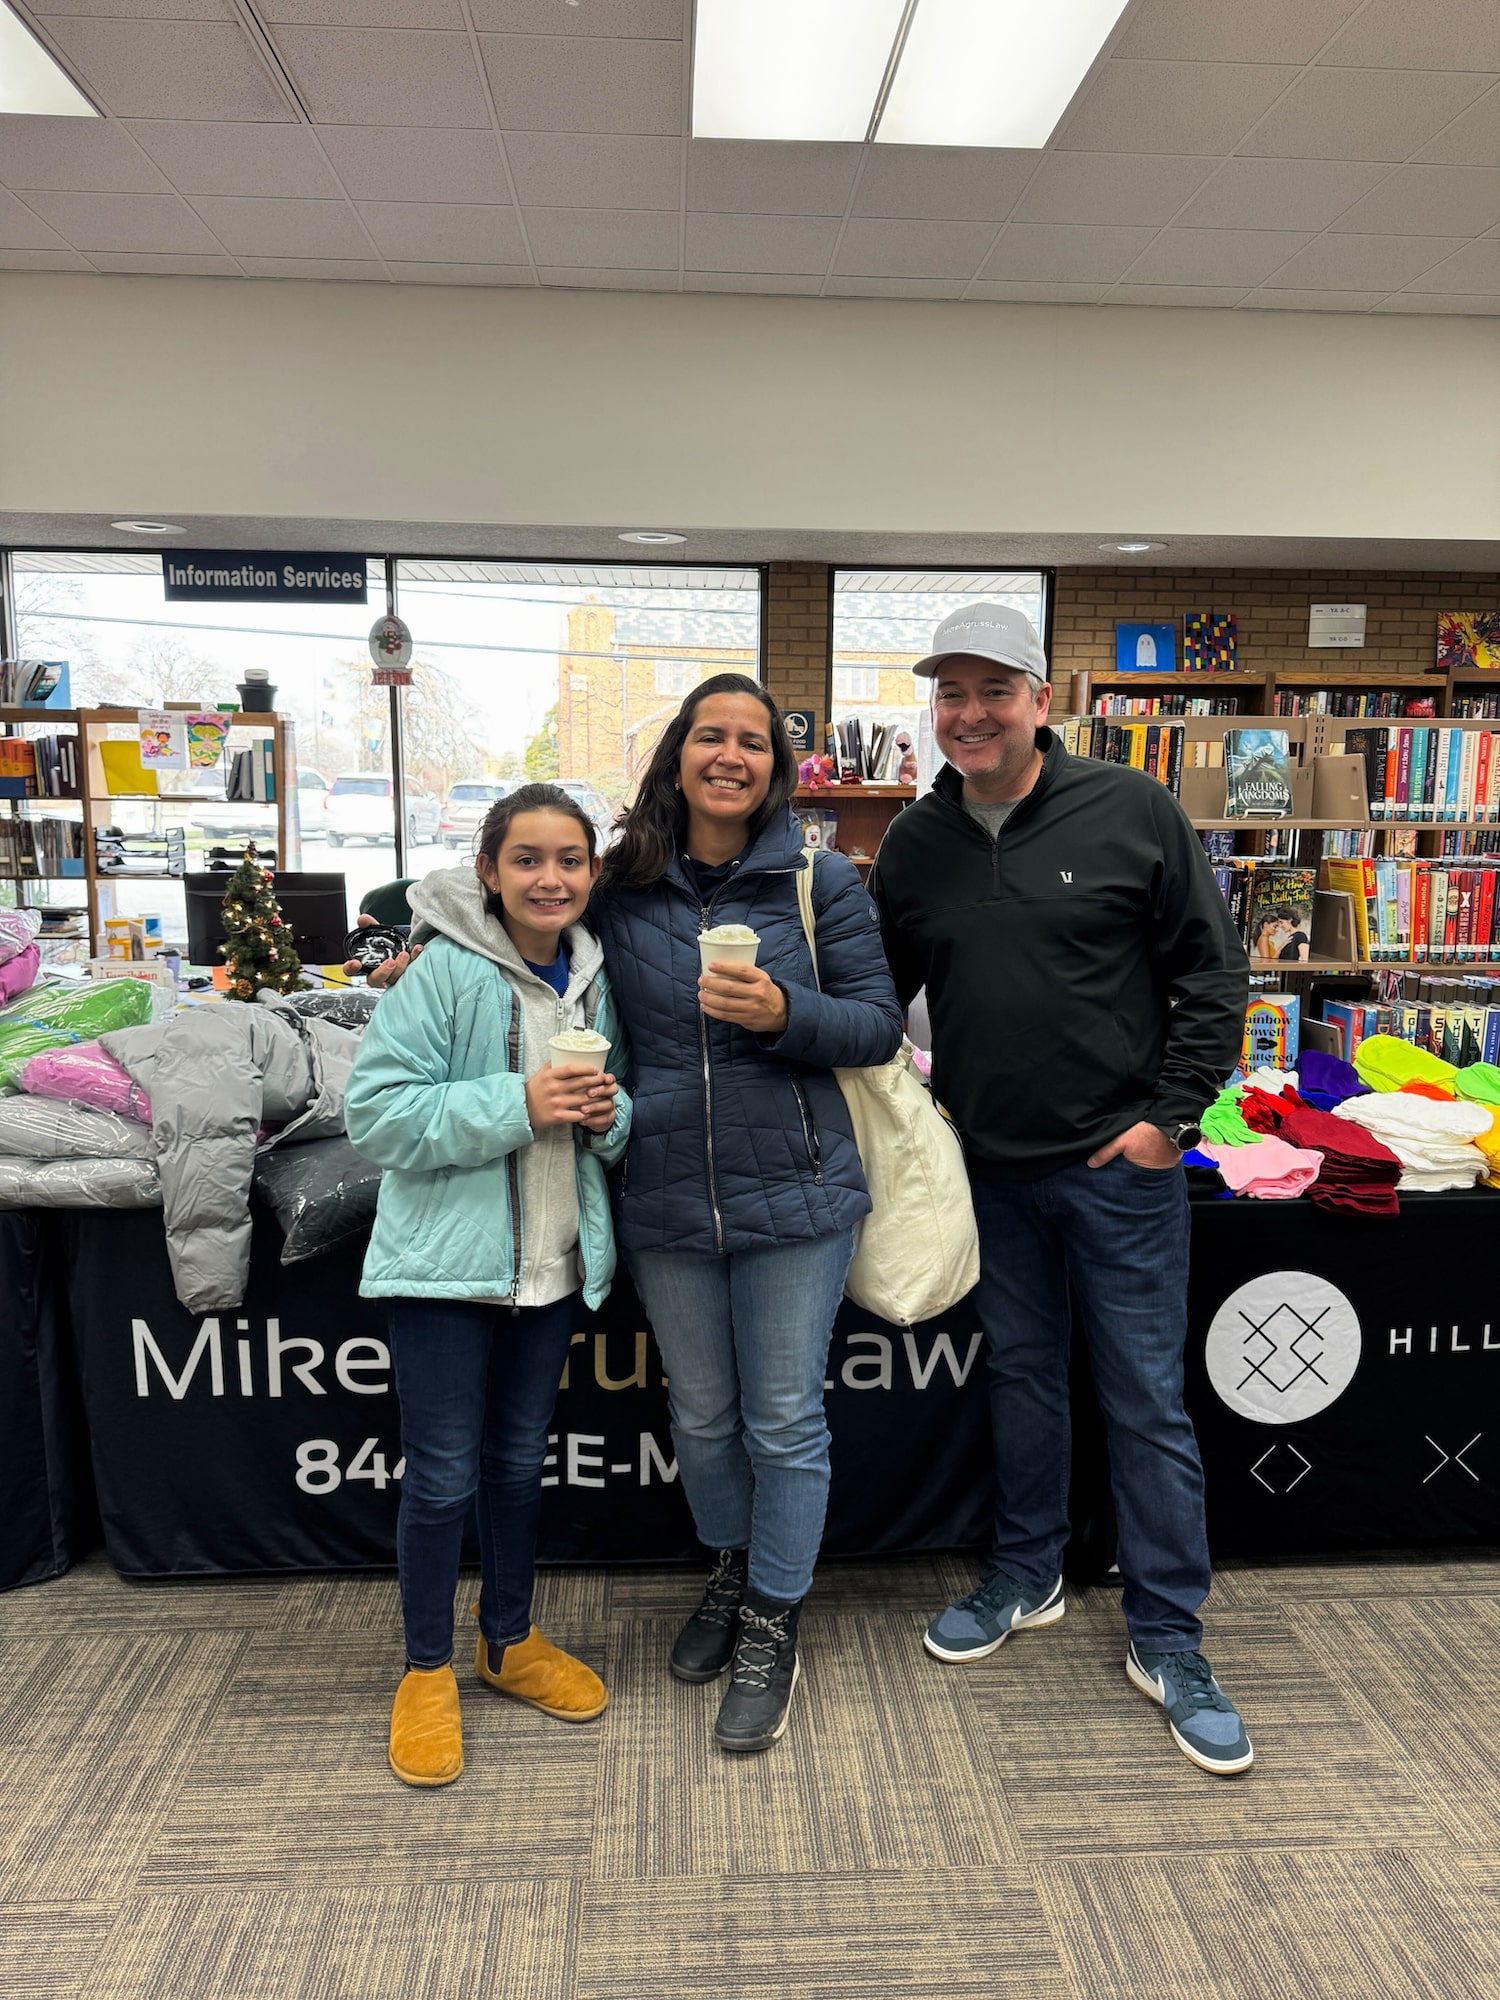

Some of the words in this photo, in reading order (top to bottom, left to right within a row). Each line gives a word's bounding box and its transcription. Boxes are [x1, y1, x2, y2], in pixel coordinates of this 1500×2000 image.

[168, 563, 278, 588] Information
[283, 565, 363, 589] Services
[1244, 782, 1282, 791] FALLING
[1238, 785, 1289, 805] KINGDOMS
[1287, 878, 1304, 889] How
[1271, 890, 1293, 905] Really
[1434, 905, 1444, 924] SALT
[1244, 1014, 1291, 1025] ainbow
[1242, 1053, 1294, 1062] cattered
